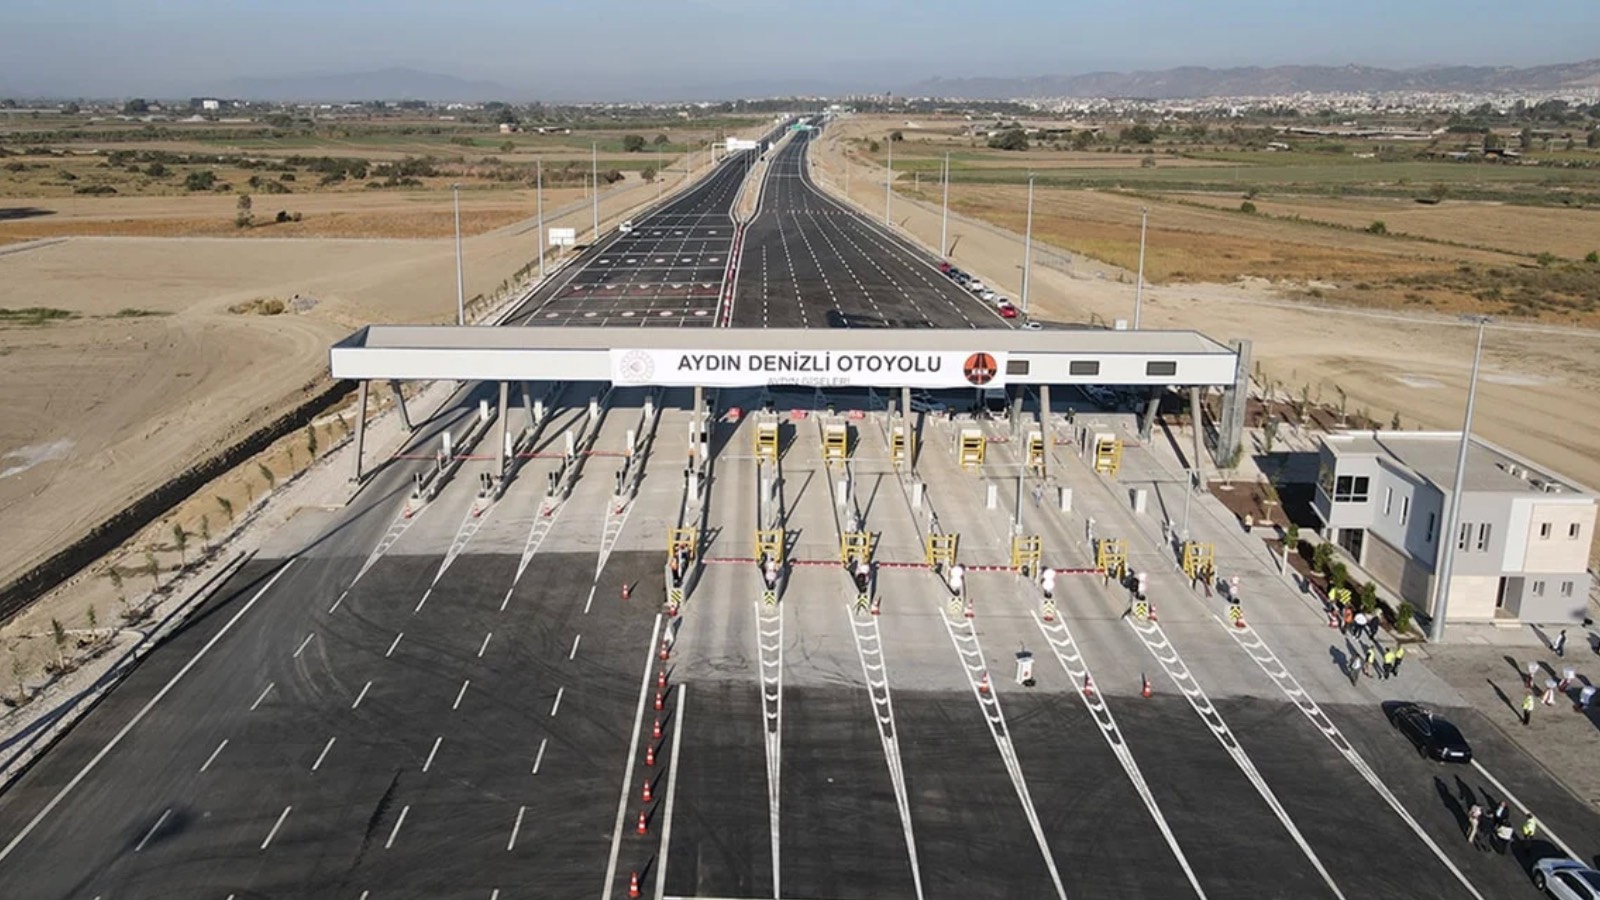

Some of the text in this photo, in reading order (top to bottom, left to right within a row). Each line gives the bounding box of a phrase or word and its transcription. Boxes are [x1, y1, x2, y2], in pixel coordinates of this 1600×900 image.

[677, 351, 942, 373] AYDIN DENİZLİ OTOYOLU
